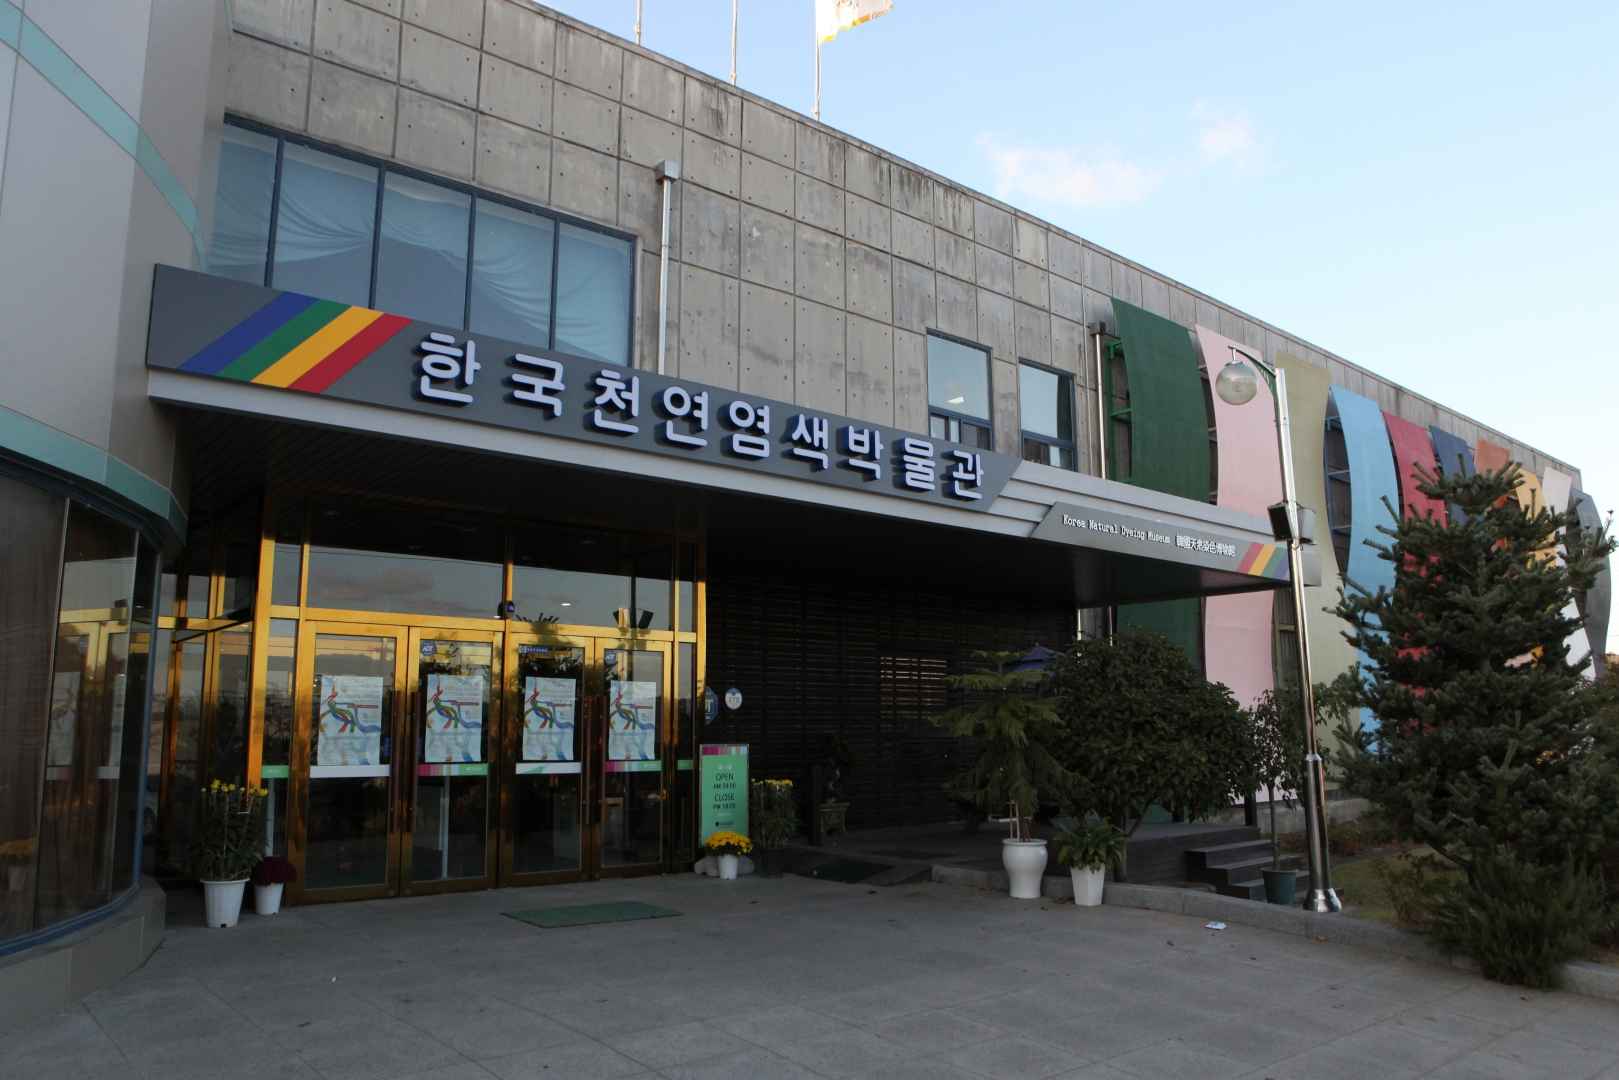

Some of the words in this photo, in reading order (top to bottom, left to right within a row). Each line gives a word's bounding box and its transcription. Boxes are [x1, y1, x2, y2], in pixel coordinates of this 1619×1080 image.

[1063, 514, 1086, 527] Korea
[1089, 519, 1118, 534] Natural
[1121, 526, 1145, 540] Dyeing
[1147, 531, 1170, 544] Museum
[715, 772, 734, 781] OPEN
[714, 793, 735, 802] CLOSE
